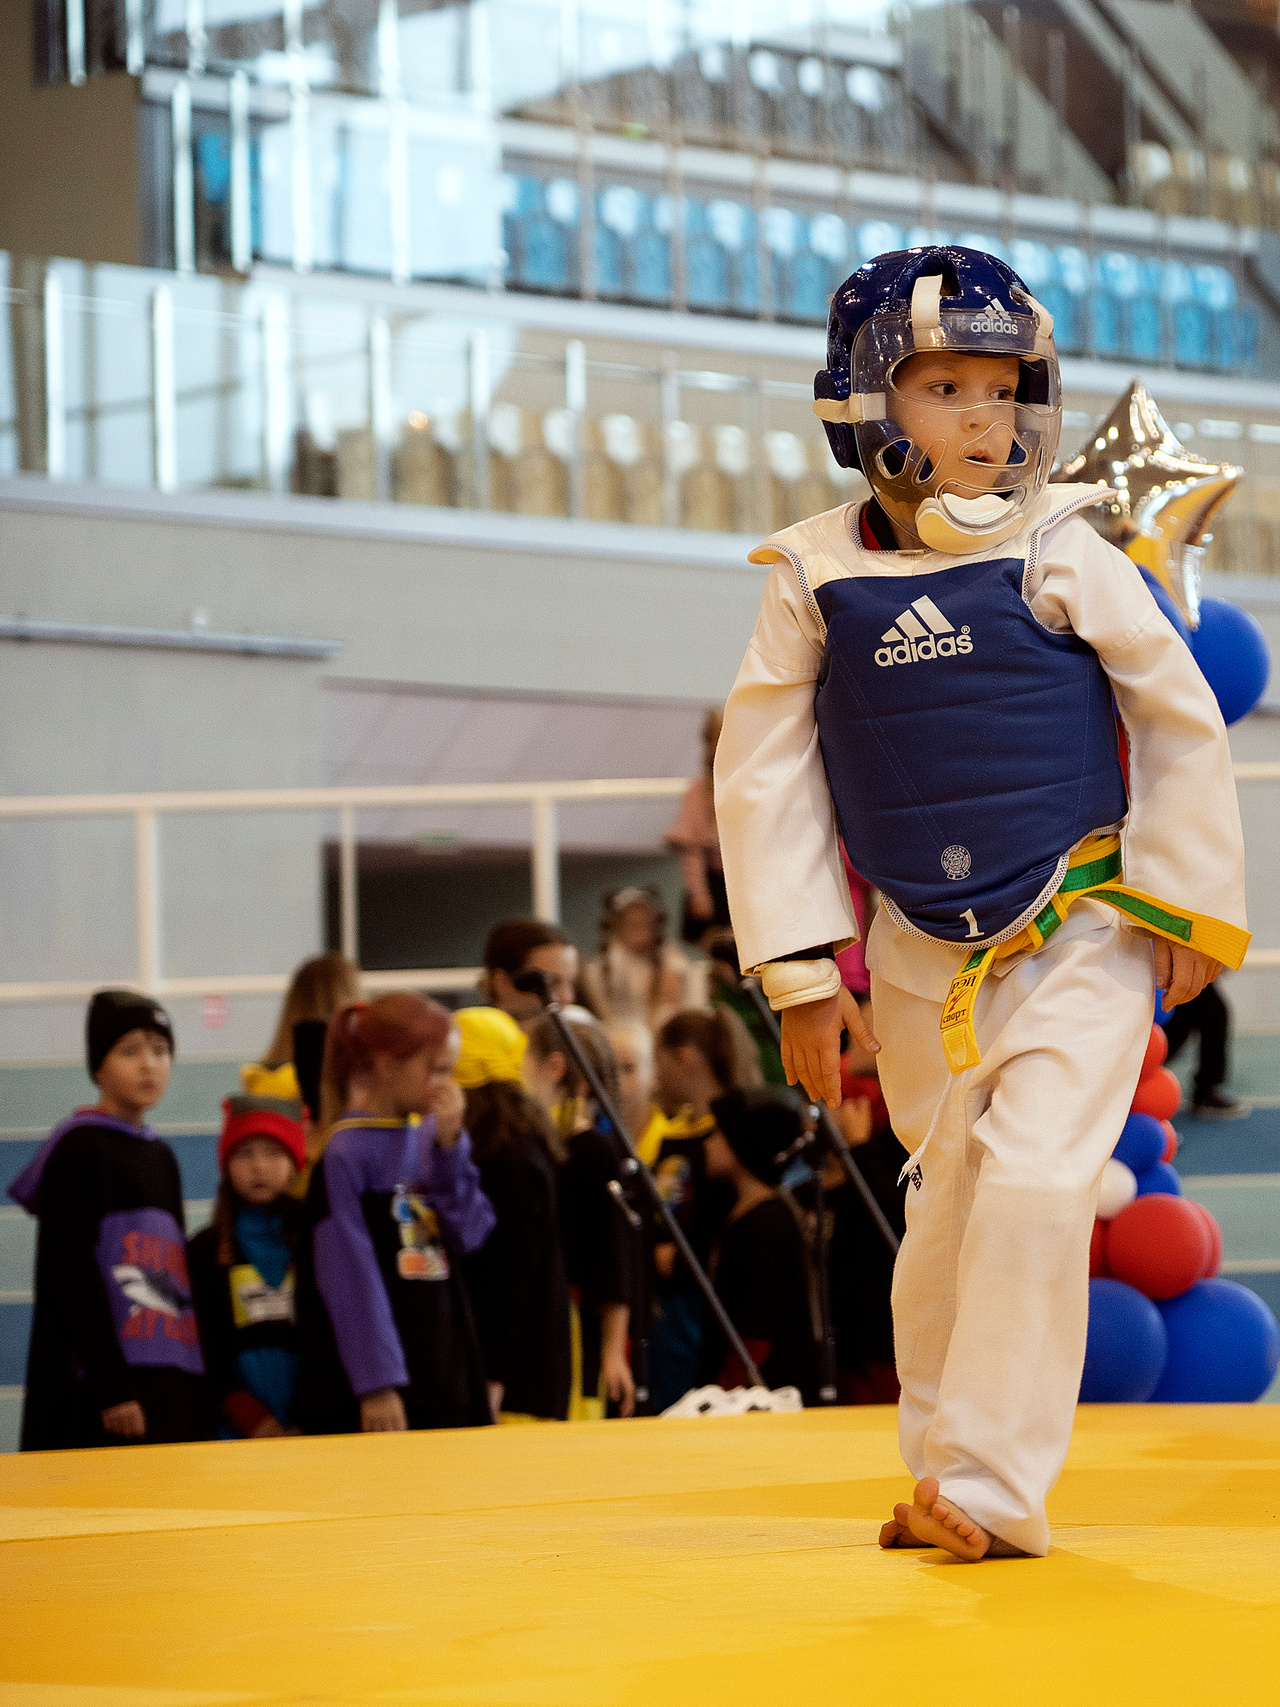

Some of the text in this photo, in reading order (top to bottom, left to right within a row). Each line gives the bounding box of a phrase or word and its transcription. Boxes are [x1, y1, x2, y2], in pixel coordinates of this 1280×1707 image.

[971, 318, 1018, 335] adidas
[874, 633, 974, 667] adidas
[959, 908, 985, 938] 1
